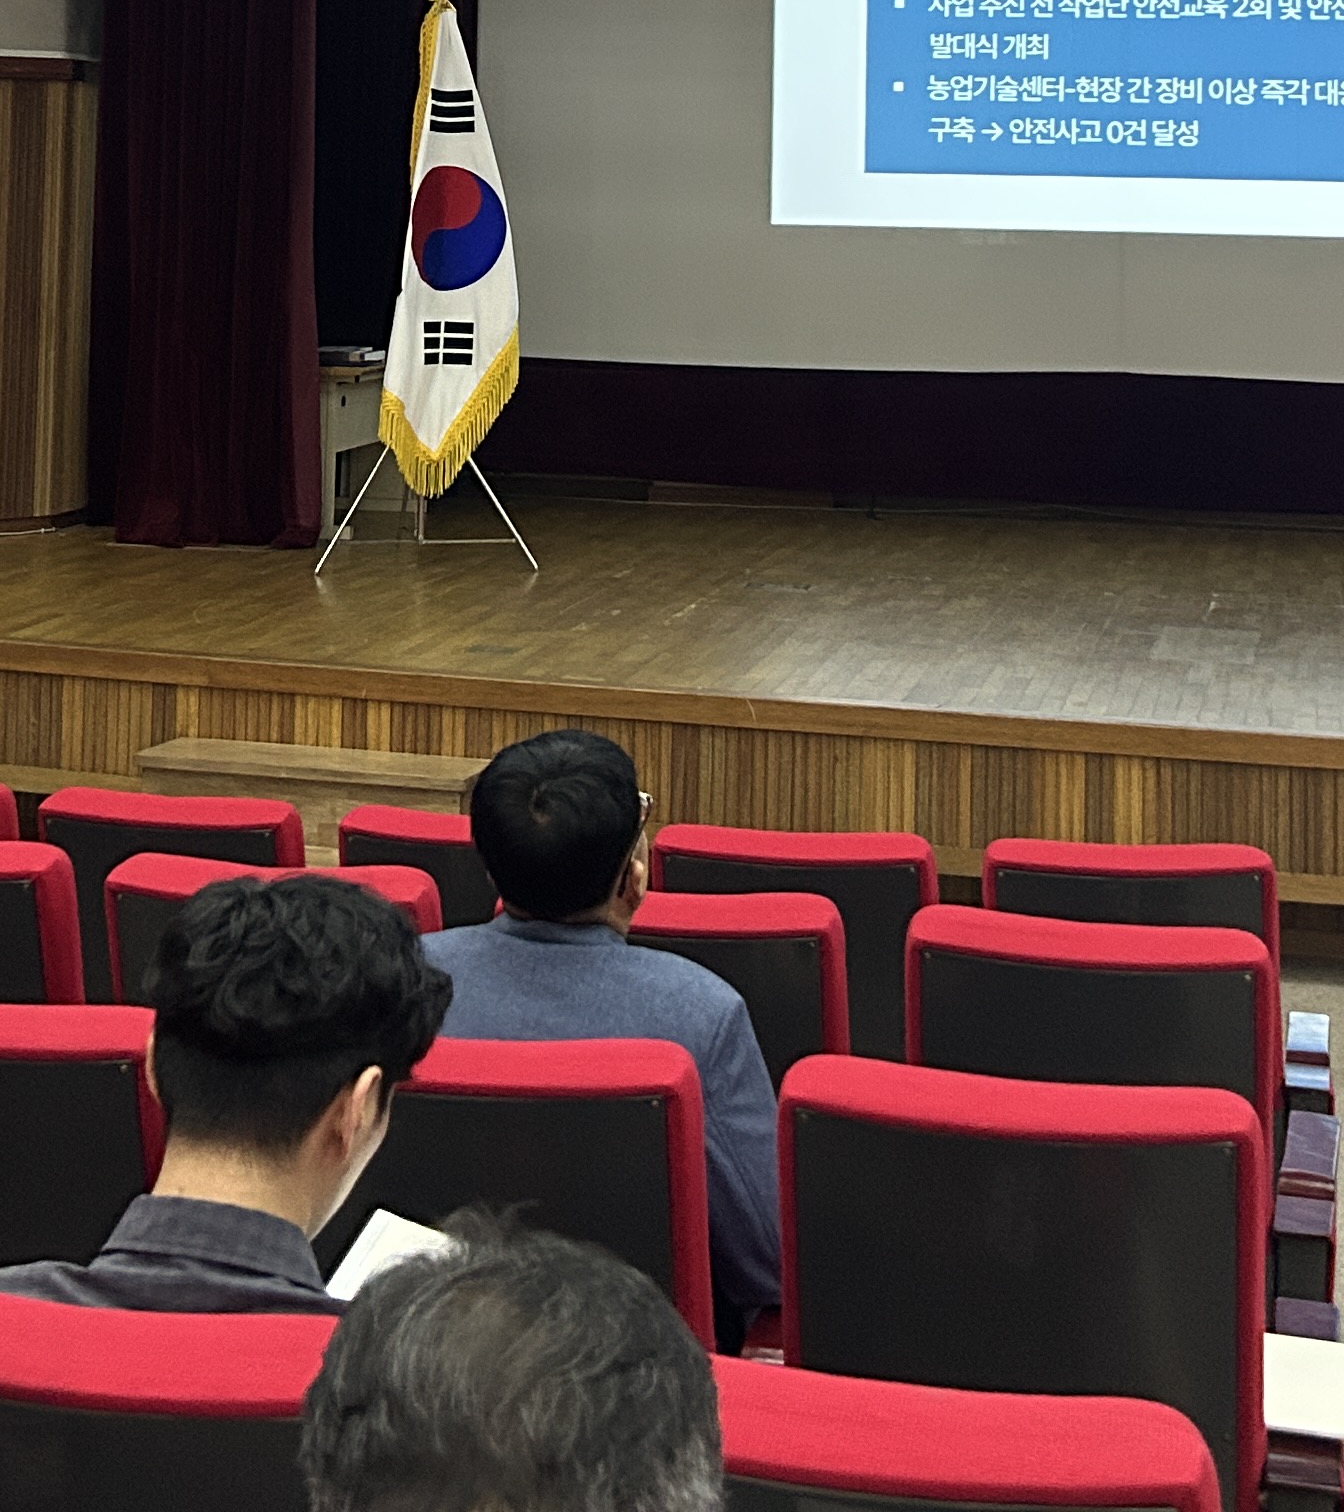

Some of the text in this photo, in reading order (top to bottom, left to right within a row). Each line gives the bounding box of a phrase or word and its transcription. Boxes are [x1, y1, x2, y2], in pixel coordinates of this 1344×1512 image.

[930, 33, 1049, 59] 발대식 개최
[927, 75, 1124, 103] 농업기술센터-현장
[1127, 77, 1152, 103] 간
[1156, 77, 1202, 104] 장비
[1209, 78, 1257, 105] 이상
[1261, 79, 1309, 105] 즉각
[928, 117, 1198, 146] 구축 안전사고 0건 달성
